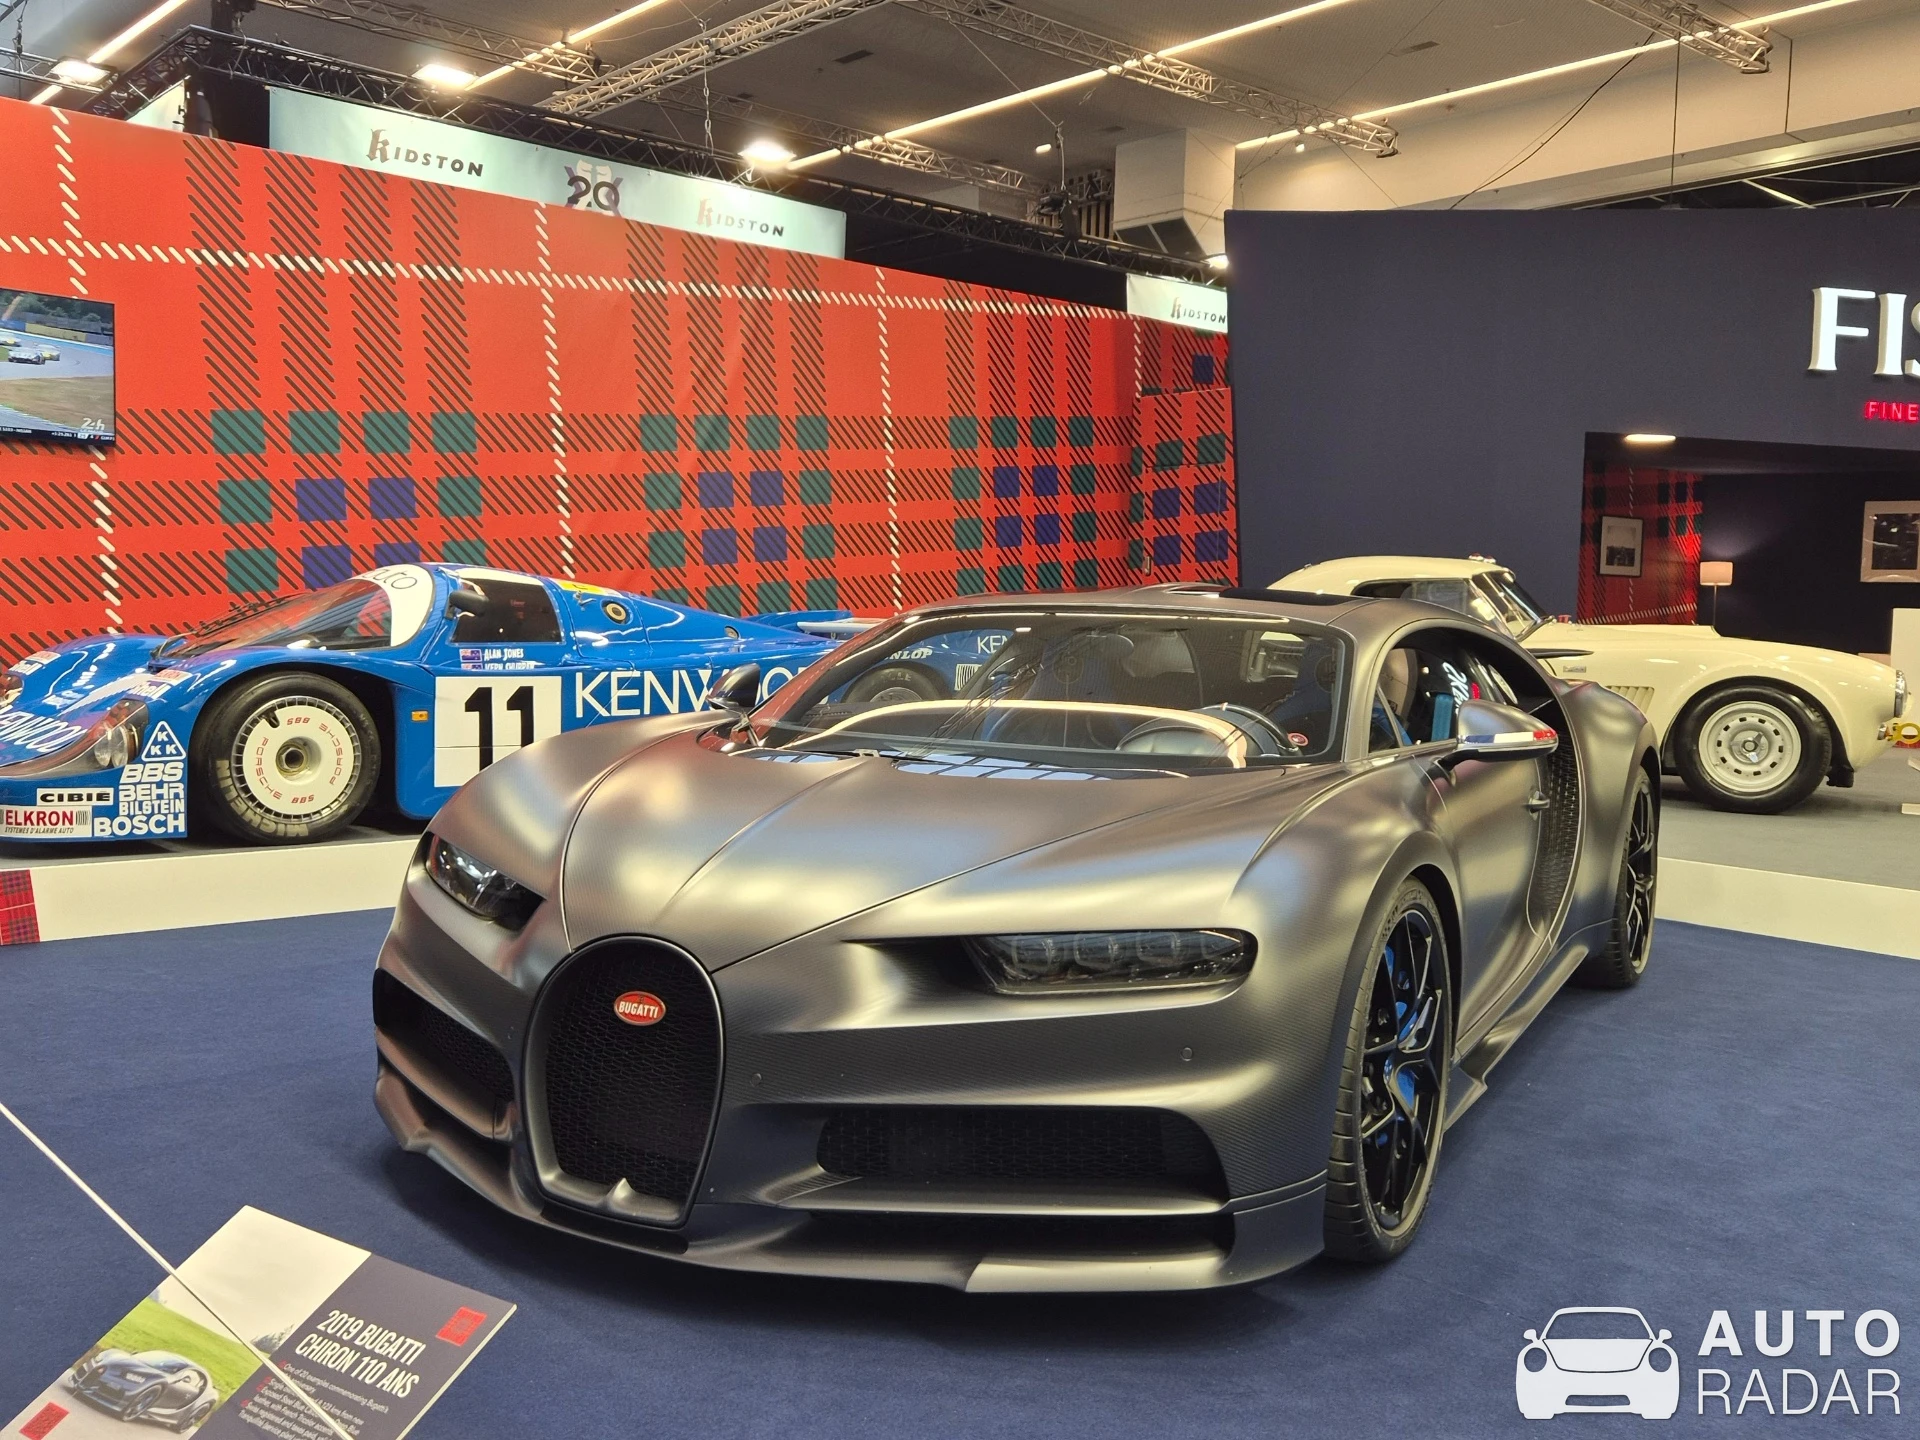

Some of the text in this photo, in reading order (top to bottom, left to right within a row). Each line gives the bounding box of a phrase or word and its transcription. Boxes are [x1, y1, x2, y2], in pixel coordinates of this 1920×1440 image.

[1866, 401, 1919, 422] FINE
[464, 686, 534, 772] 11
[119, 761, 184, 784] BBS
[255, 736, 283, 800] PORSCHE
[119, 782, 185, 802] BEHR
[5, 809, 74, 827] ELKRON
[119, 799, 185, 817] BILSTEIN
[93, 813, 186, 837] BOSCH
[618, 1001, 659, 1018] BUGATTI
[316, 1309, 427, 1366] 2019 BUGATTI
[295, 1333, 420, 1399] CHIRON 110 ANS
